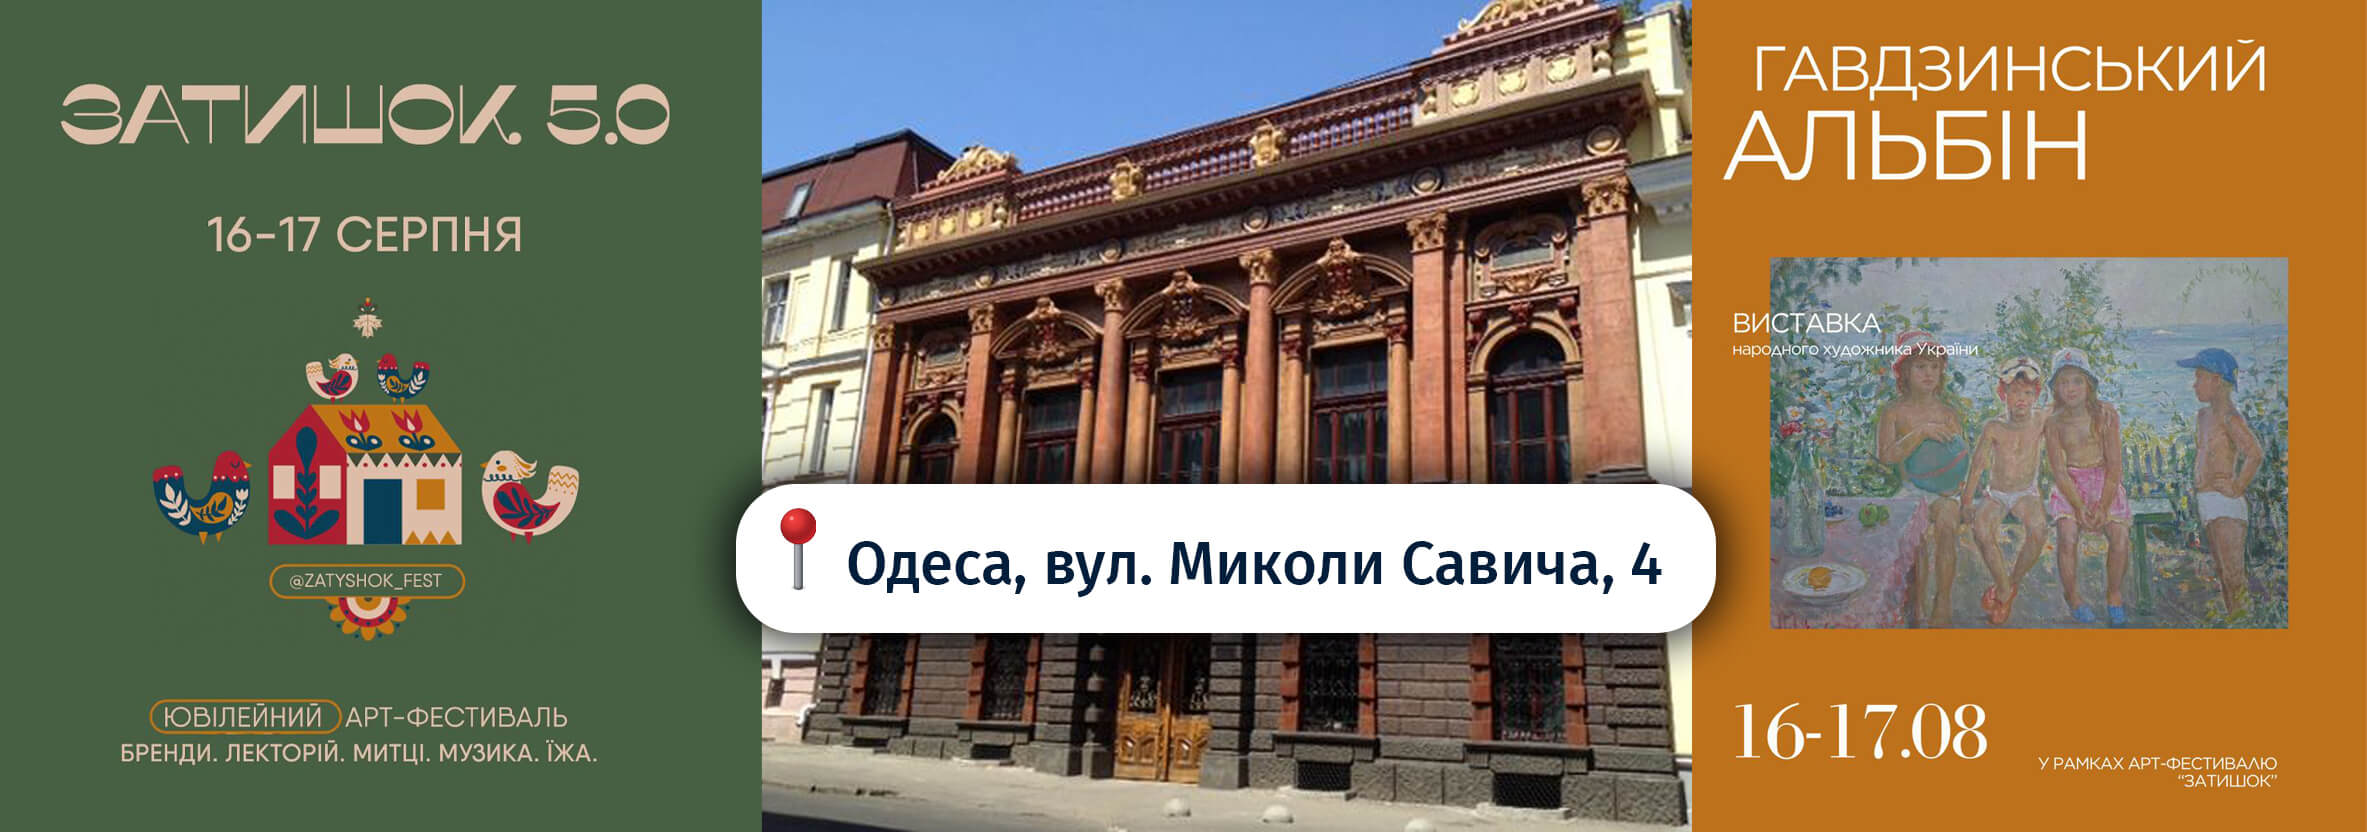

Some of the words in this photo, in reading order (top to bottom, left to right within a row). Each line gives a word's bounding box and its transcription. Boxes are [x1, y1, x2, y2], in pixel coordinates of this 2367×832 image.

[1756, 39, 2265, 102] ГАВДЗИНСЬКИЙ
[60, 83, 523, 146] ЗАТИШОК
[546, 83, 671, 146] 5.0
[1722, 109, 2086, 181] АЛЬБІН
[207, 215, 321, 253] 16-17
[336, 215, 521, 253] СЕРПНЯ
[1732, 312, 1882, 334] ВИСТАВКА
[1732, 343, 1819, 358] народного
[1823, 343, 1912, 358] художника
[1916, 341, 1979, 357] України
[289, 572, 443, 591] @ZATYSHOK_FEST
[164, 702, 322, 728] ЮВІЛЕЙНИЙ
[344, 705, 568, 728] АРТ-ФЕСТИВАЛЬ
[1735, 702, 1988, 761] 16-17.08
[120, 743, 218, 767] БРЕНДИ.
[224, 739, 345, 763] ЛЕКТОРІЙ.
[353, 743, 431, 766] МИТЦІ.
[439, 742, 540, 763] МУЗИКА.
[545, 739, 598, 763] ЇЖА.
[2038, 756, 2050, 770] У
[2053, 756, 2124, 771] РАМКАХ
[2128, 756, 2278, 771] АРТ-ФЕСТИВАЛЮ
[2178, 774, 2278, 788] “ЗАТИШОК”
